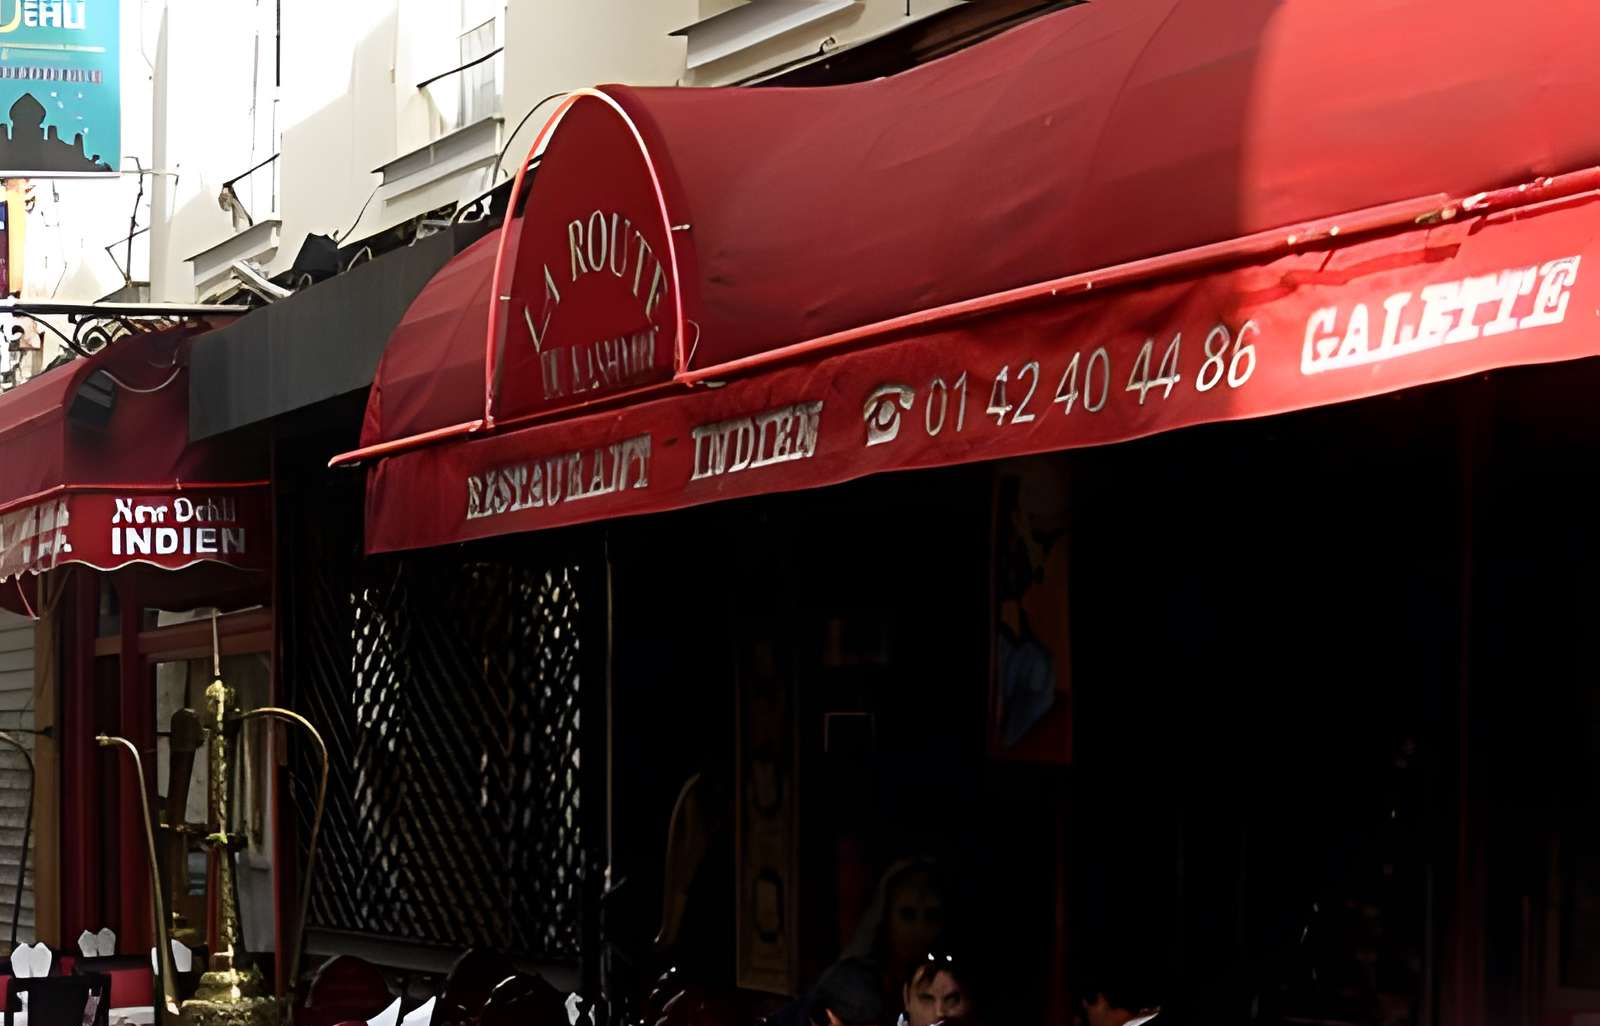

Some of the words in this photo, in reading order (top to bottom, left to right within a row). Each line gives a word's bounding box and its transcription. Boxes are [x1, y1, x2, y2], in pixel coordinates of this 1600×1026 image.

[568, 209, 668, 325] ROUTE
[1300, 255, 1582, 376] GALETTE
[925, 370, 966, 437] 01
[985, 361, 1040, 426] 42
[1053, 343, 1111, 415] 40
[1124, 332, 1182, 405] 44
[1194, 320, 1260, 393] 86
[466, 432, 652, 520] RESTAURANT
[690, 400, 824, 482] INDIEN
[111, 526, 246, 556] INDIEN
